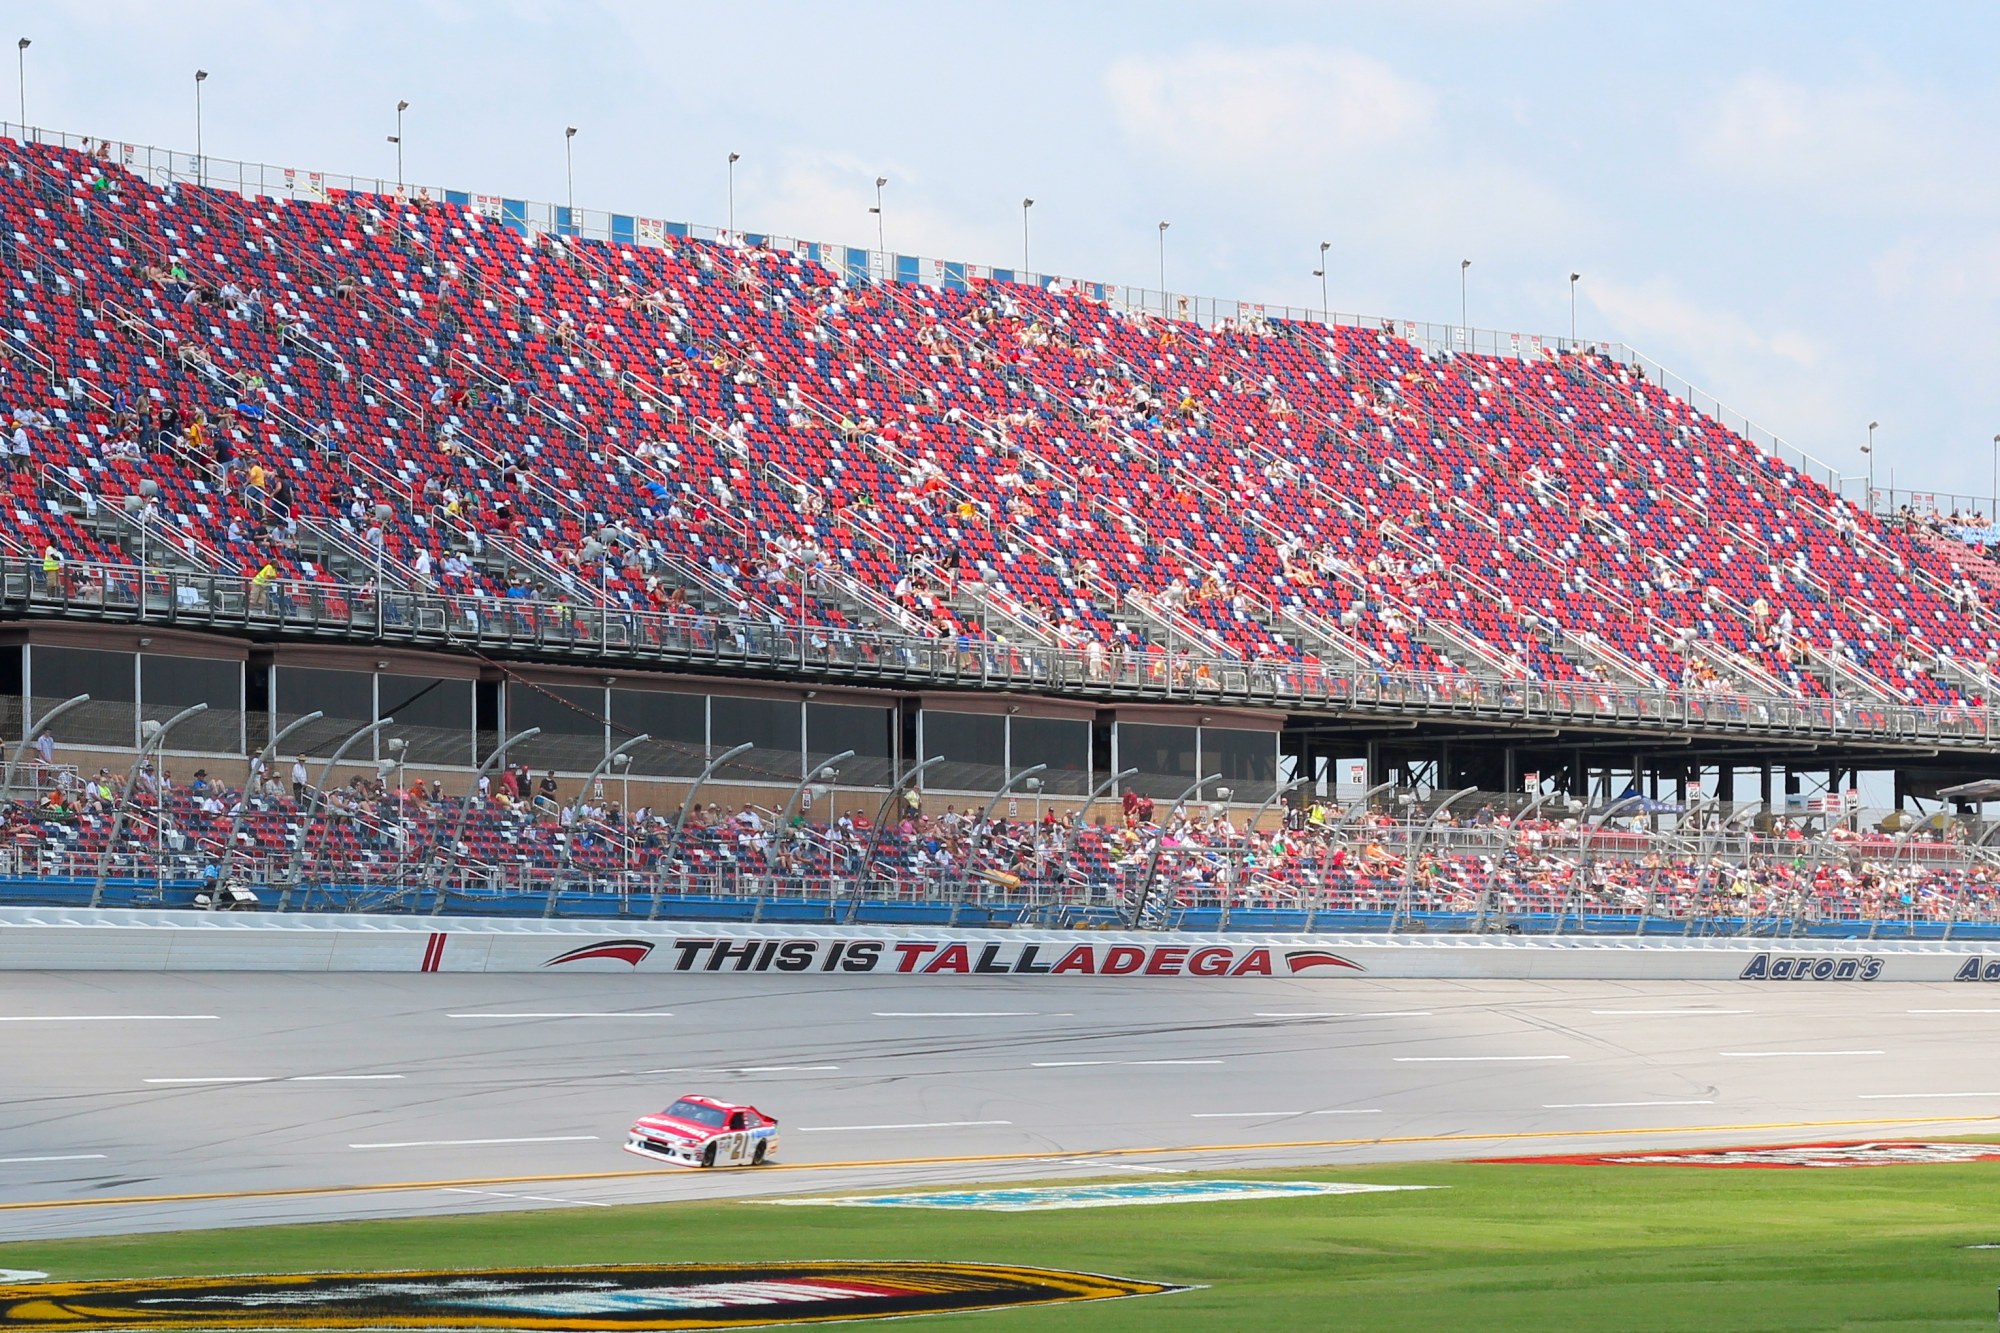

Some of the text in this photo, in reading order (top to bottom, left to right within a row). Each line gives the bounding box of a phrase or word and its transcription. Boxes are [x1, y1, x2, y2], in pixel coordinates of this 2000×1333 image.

[1353, 776, 1362, 784] EE
[673, 937, 1273, 976] THIS IS TALLADEGA
[1739, 952, 1885, 980] Aaron's
[730, 1133, 749, 1160] 21
